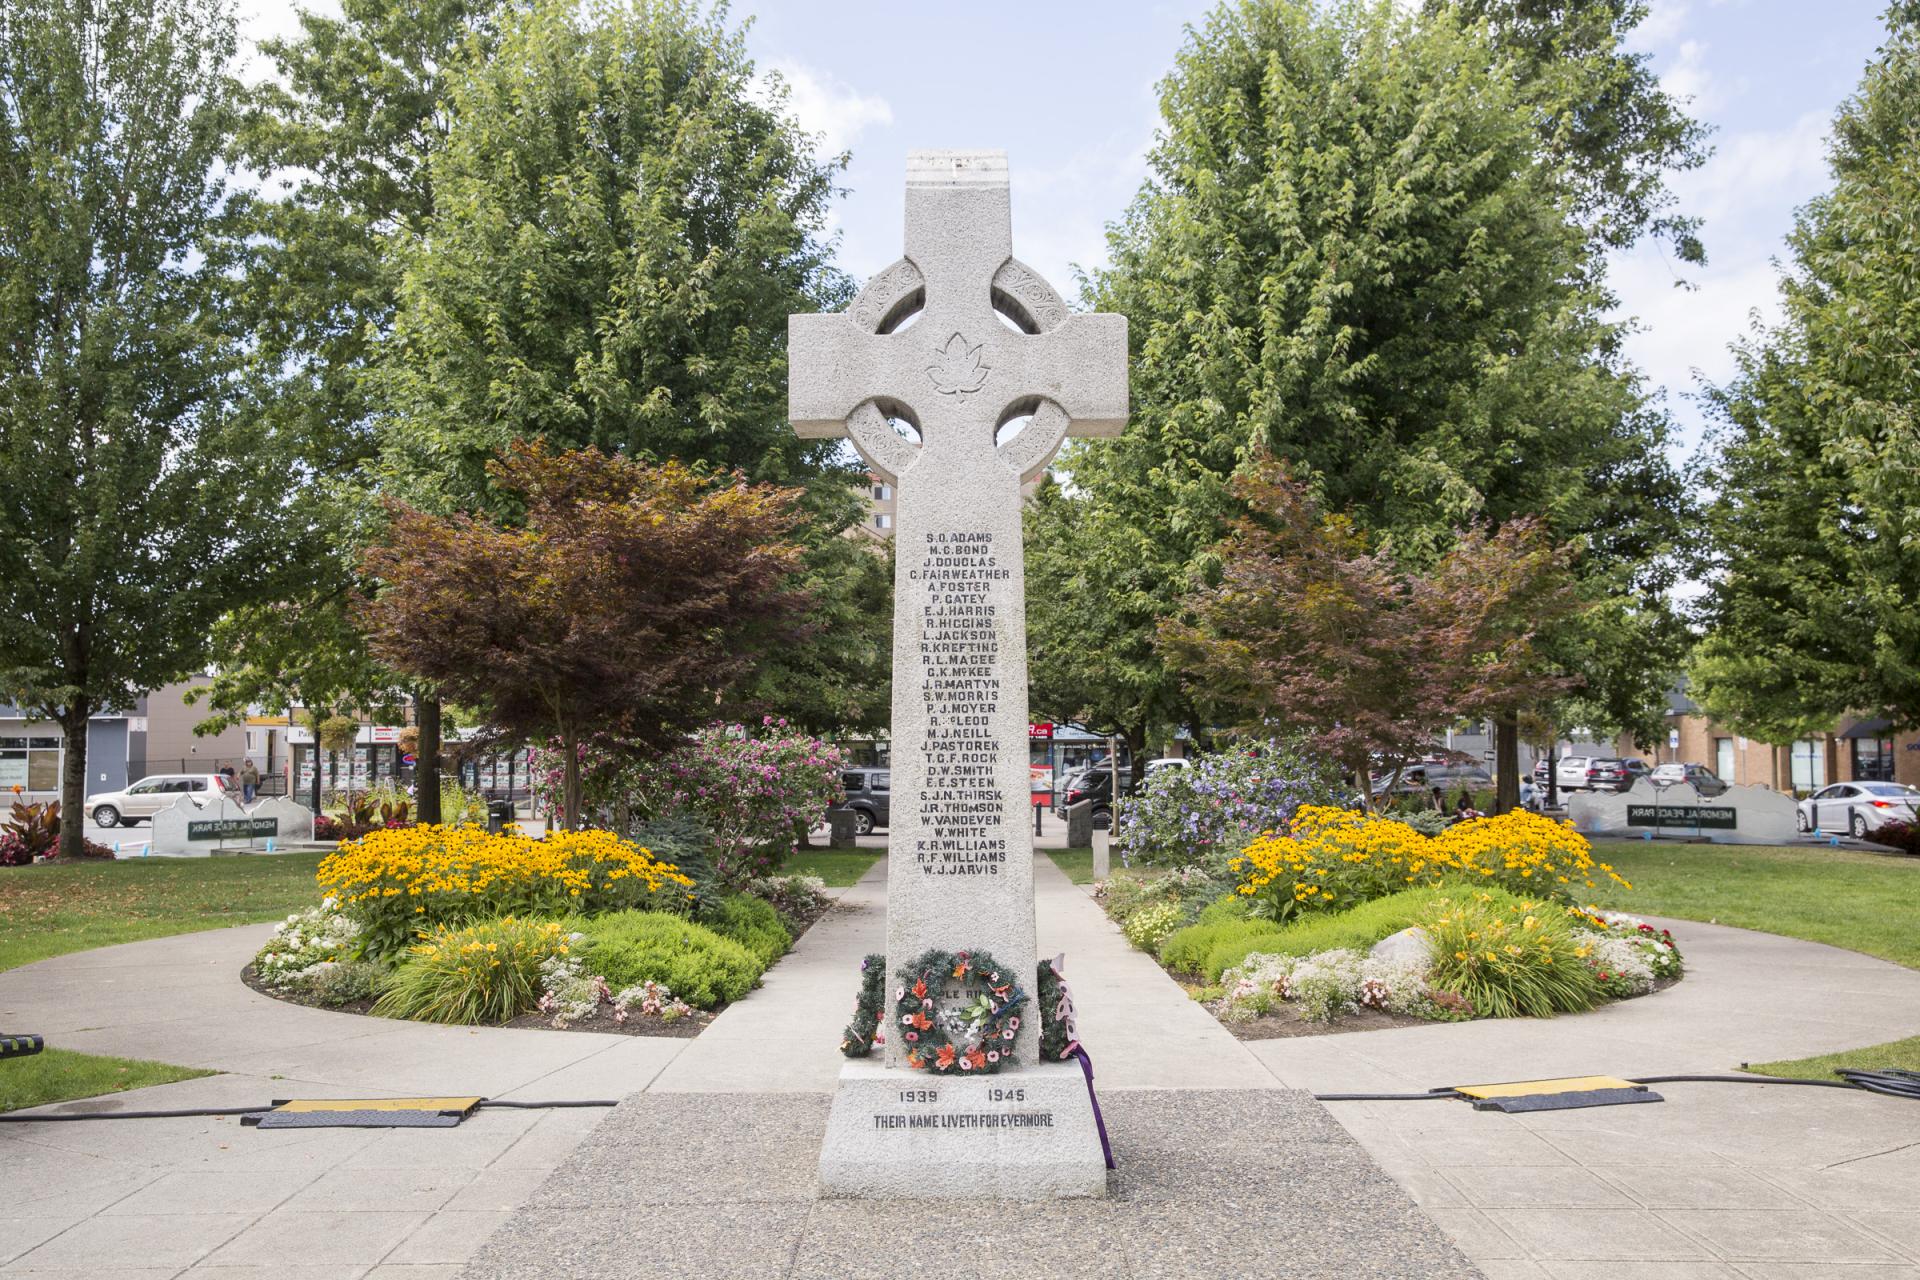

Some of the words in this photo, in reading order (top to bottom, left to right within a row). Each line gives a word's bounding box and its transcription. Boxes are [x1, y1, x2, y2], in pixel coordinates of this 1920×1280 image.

[930, 546, 988, 555] M.C.BOND
[924, 558, 996, 567] J.DOUGLAS
[928, 582, 990, 592] A.FOSTER
[925, 606, 995, 616] E.J.HARRIS
[927, 619, 992, 628] R.HIGGINS
[924, 631, 996, 640] L.JACKSON
[921, 643, 998, 653] R.KREFTING
[923, 655, 996, 665] R.L.MAGEE
[924, 691, 998, 701] S.W.MORRIS
[927, 729, 991, 738] M.J.NEILL
[920, 741, 1000, 751] J.PASTOREK
[928, 766, 993, 775] D.W.SMITH
[927, 778, 994, 788] E.E.STEEN
[920, 790, 1002, 801] S.J.N.THIRSK
[920, 803, 1003, 813] J.R.THOMSON
[921, 815, 1001, 825] W.VANDEVEN
[935, 828, 987, 837] W.WHITE
[917, 840, 1006, 850] K.R.WILLIAMS
[917, 852, 1006, 863] R.F.WILLIAMS
[923, 864, 998, 875] W.J.JARVIS
[900, 1090, 938, 1103] 1939
[988, 1089, 1025, 1102] 1945
[874, 1115, 906, 1129] THEIR
[909, 1115, 939, 1128] NAME
[941, 1114, 978, 1128] LIVETH
[980, 1114, 999, 1128] FOR
[1001, 1114, 1054, 1128] EVERMORE
